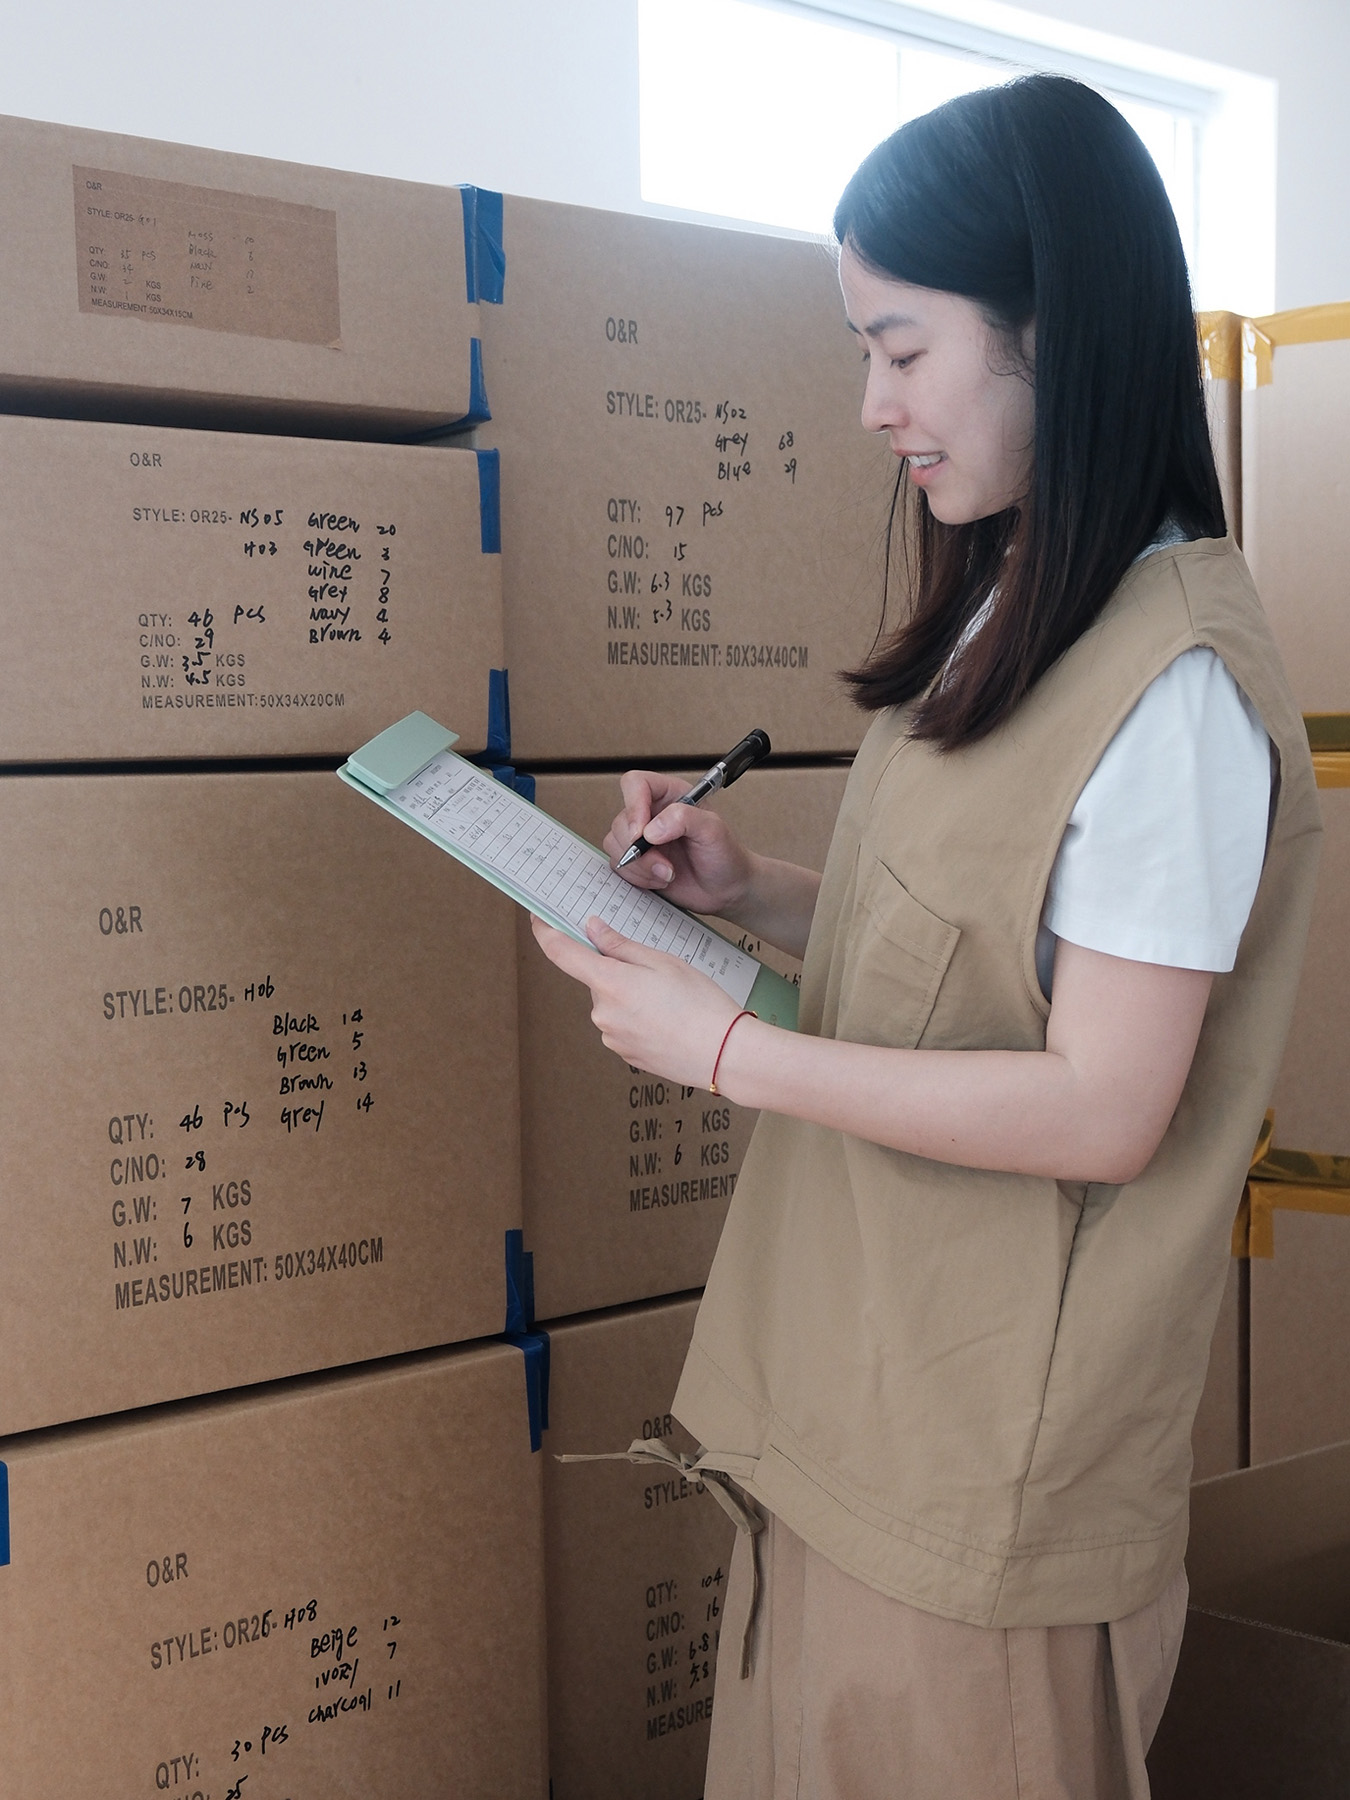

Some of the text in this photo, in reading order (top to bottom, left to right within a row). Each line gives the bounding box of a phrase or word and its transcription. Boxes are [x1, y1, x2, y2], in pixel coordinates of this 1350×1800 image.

[86, 181, 102, 190] O&R
[145, 281, 161, 289] KGS
[145, 293, 161, 302] KGS
[605, 317, 638, 344] O&R
[606, 391, 659, 419] STYLE:
[664, 399, 707, 423] OR25-
[778, 431, 794, 450] 68
[130, 453, 162, 467] O&R
[133, 508, 186, 522] STYLE:
[190, 510, 233, 523] OR25-
[376, 525, 396, 536] 20
[607, 499, 641, 524] QTY:
[665, 506, 684, 527] 97
[381, 547, 390, 561] 3
[607, 535, 687, 561] C/NO: 15
[381, 569, 391, 585] 7
[607, 571, 641, 594] G.W:
[682, 574, 712, 597] KGS
[378, 586, 390, 604] 8
[138, 613, 173, 628] QTY:
[187, 608, 214, 628] 46
[376, 608, 388, 623] 4
[607, 606, 640, 629] N.W:
[681, 609, 711, 631] KGS
[139, 634, 181, 648] C/NO:
[378, 628, 391, 645] 4
[140, 654, 174, 668] G.W:
[215, 653, 246, 668] KGS
[607, 642, 809, 668] MEASUREMENT: 50X34X40CM
[141, 675, 174, 688] N.W:
[216, 674, 246, 687] KGS
[99, 906, 143, 935] O&R
[103, 987, 174, 1020] STYLE:
[178, 983, 236, 1013] OR25-
[342, 1009, 364, 1026] 14
[352, 1031, 364, 1051] 5
[353, 1062, 367, 1082] 13
[356, 1093, 374, 1113] 14
[629, 1083, 670, 1109] C/NO:
[108, 1113, 155, 1145] QTY:
[179, 1104, 204, 1132] 46
[629, 1108, 731, 1143] G.W: 7 KGS
[110, 1150, 206, 1186] C/NO: 28
[630, 1142, 730, 1178] N.W: 6 KGS
[112, 1180, 252, 1227] G.W: 7 KGS
[113, 1220, 252, 1269] N.W: 6 KGS
[114, 1237, 384, 1310] MEASUREMENT: 50X34X40CM
[642, 1414, 673, 1440] O&R
[146, 1552, 189, 1587] O&R
[645, 1568, 723, 1608] QTY: 104
[383, 1616, 401, 1630] 12
[646, 1611, 685, 1642] C/NO:
[707, 1596, 720, 1622] 16
[150, 1627, 218, 1669] STYLE:
[387, 1641, 397, 1659] 7
[646, 1646, 678, 1675] G.W:
[388, 1680, 401, 1699] 11
[647, 1679, 677, 1708] N.W:
[155, 1753, 199, 1789] QTY:
[231, 1740, 252, 1761] 30
